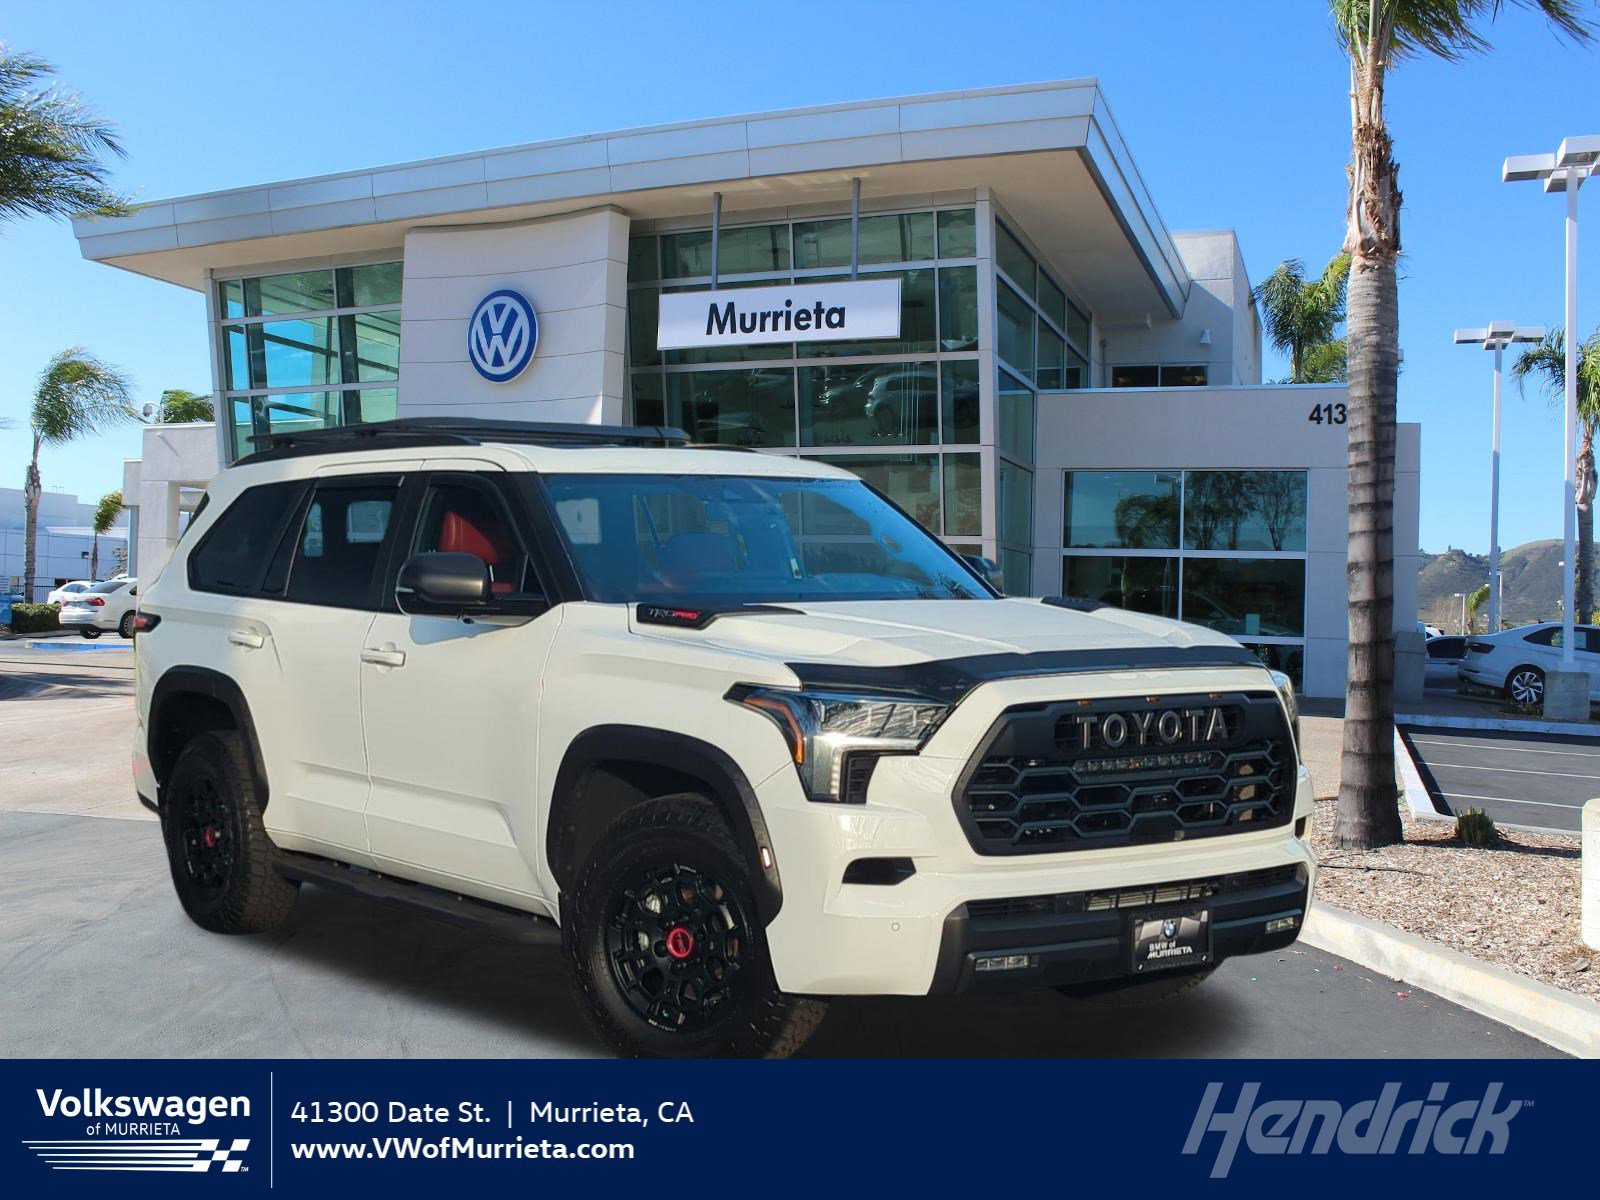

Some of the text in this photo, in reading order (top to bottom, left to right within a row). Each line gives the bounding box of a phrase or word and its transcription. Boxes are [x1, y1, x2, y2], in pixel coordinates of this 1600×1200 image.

[705, 299, 846, 336] Murrieta
[1076, 707, 1229, 749] TOYOTA
[1147, 946, 1192, 959] MURRIETA
[1149, 940, 1176, 952] BMW of
